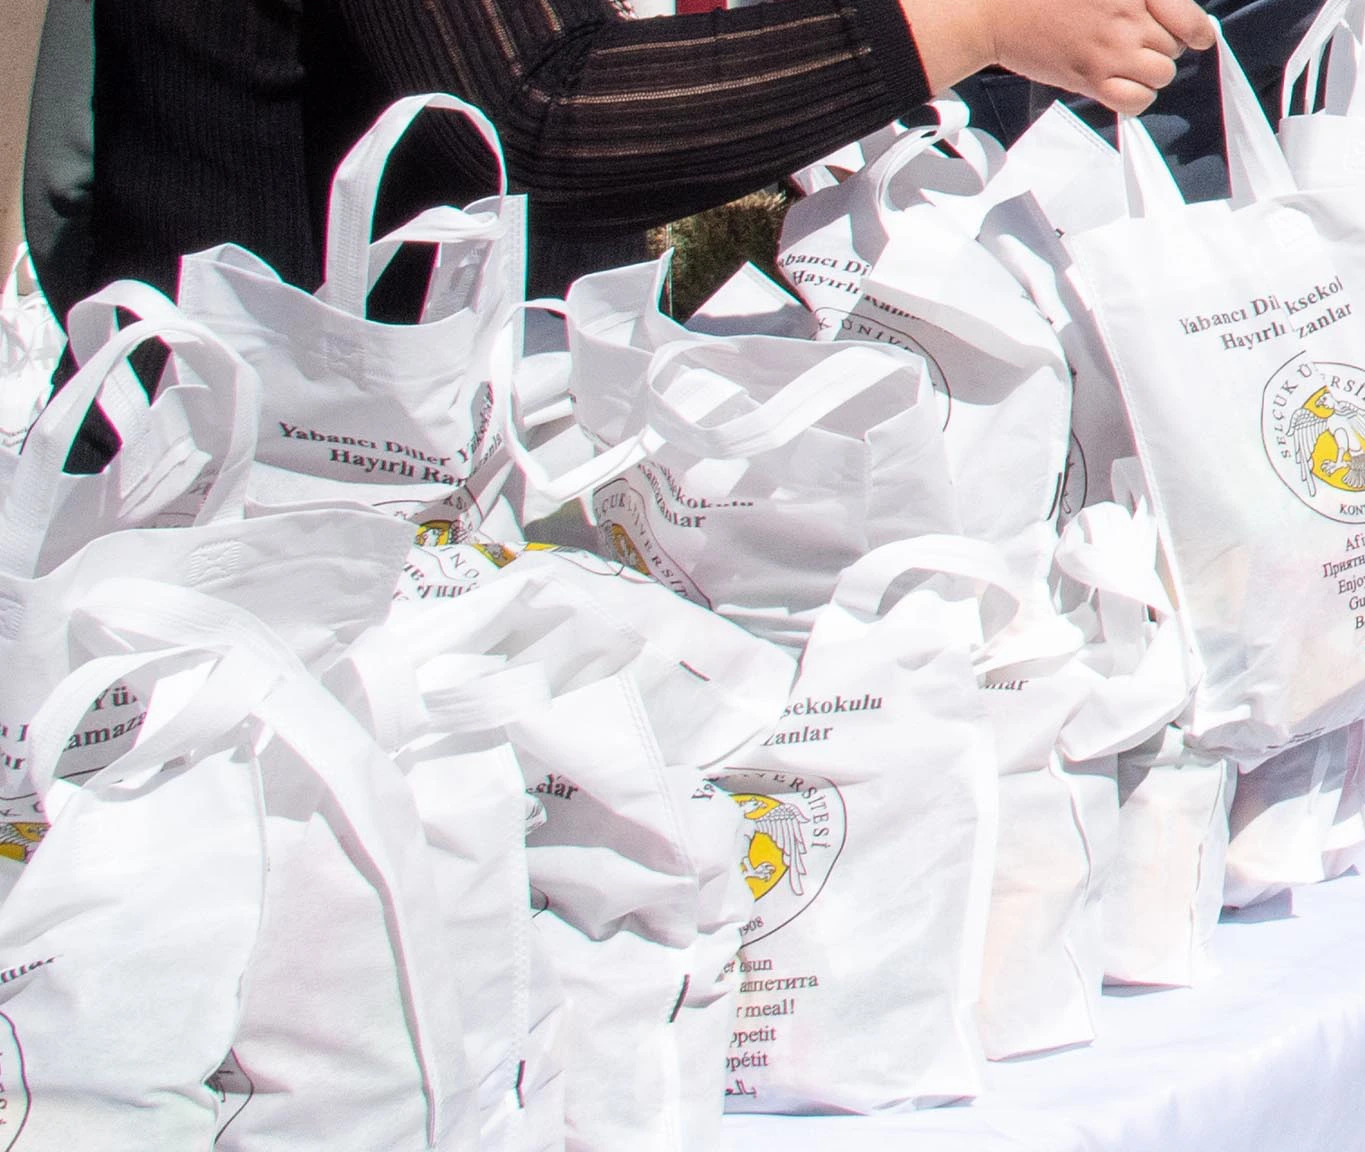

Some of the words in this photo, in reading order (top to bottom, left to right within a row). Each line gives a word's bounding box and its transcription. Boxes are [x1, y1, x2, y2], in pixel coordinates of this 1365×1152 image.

[1179, 307, 1249, 336] Yabancı
[1221, 321, 1288, 350] Hayırlı
[1295, 303, 1352, 339] zanlar
[279, 420, 377, 450] Yabancı
[329, 448, 414, 480] Hayırlı
[781, 694, 883, 720] sekokulu
[745, 998, 796, 1019] meal!
